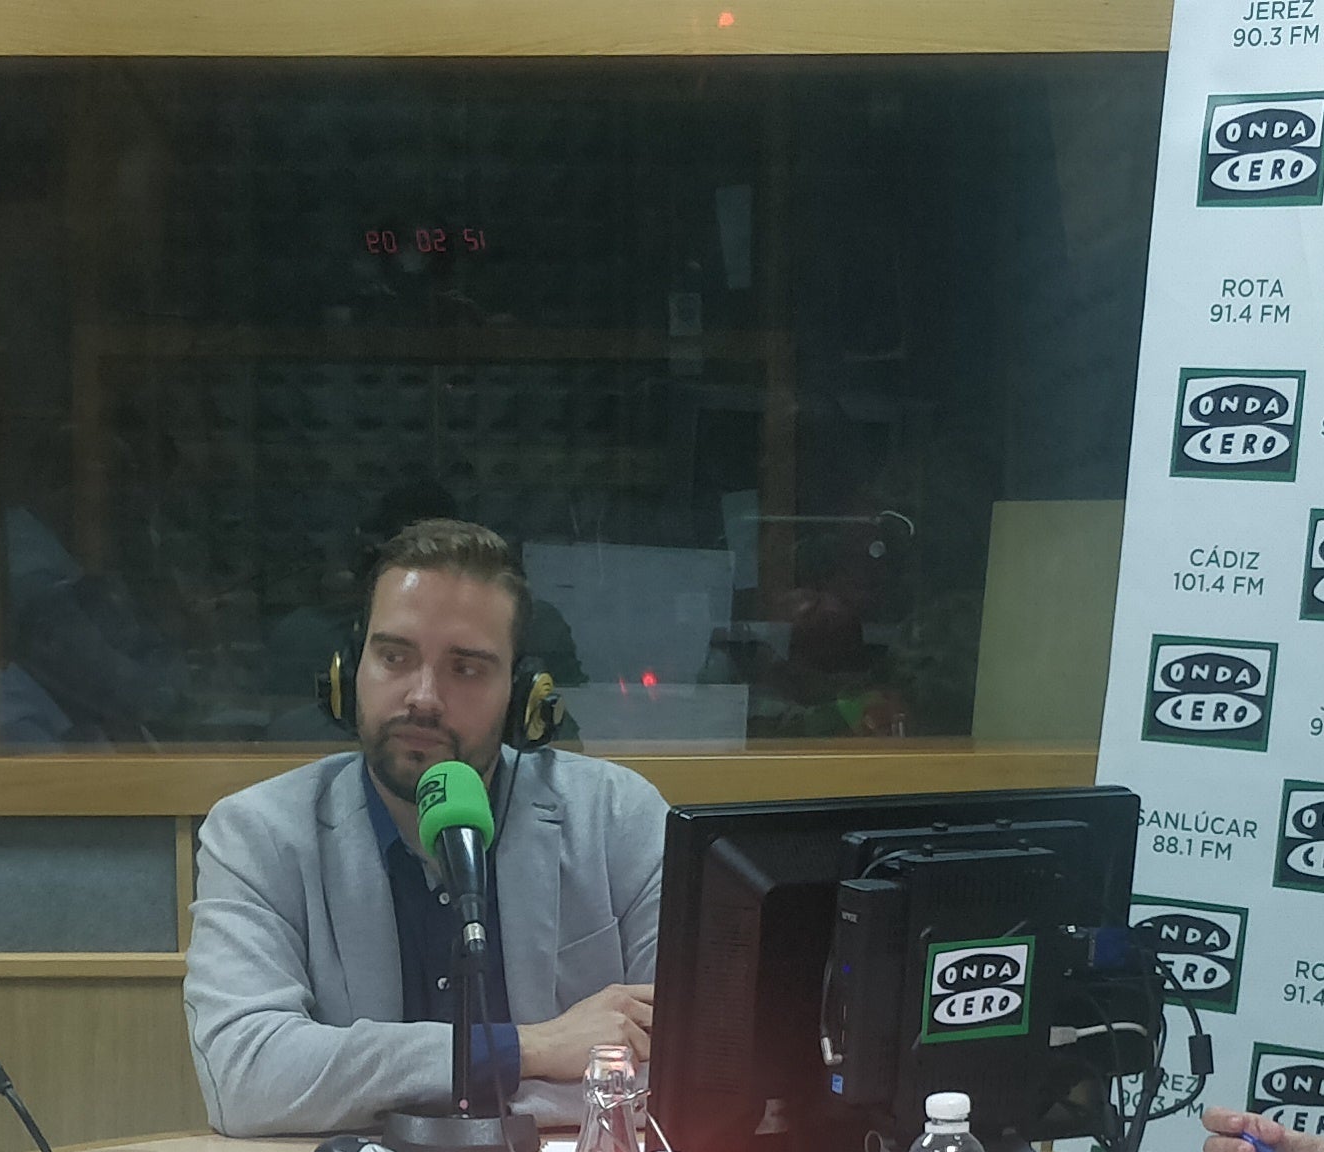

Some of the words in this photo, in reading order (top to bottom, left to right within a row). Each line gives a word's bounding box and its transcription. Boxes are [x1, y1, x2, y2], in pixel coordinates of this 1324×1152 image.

[1243, 0, 1314, 21] JEREZ
[1233, 27, 1282, 47] 90.3
[1289, 25, 1320, 45] FM
[1226, 120, 1307, 142] ONDA
[1227, 159, 1304, 183] CERO
[1221, 278, 1285, 298] ROTA
[1209, 304, 1253, 324] 91.4
[1260, 304, 1291, 324] FM
[1198, 396, 1280, 416] ONDA
[1199, 433, 1277, 455] CERO
[1189, 545, 1261, 571] CÁDIZ
[1173, 572, 1226, 593] 101.4
[1233, 575, 1265, 596] FM
[1169, 663, 1253, 685] ONDA
[1170, 700, 1249, 724] CERO
[1152, 835, 1193, 856] 88.1
[1200, 840, 1233, 861] FM
[1142, 922, 1221, 948] NDA
[944, 962, 1013, 985] ONDA
[945, 995, 1010, 1018] CERO
